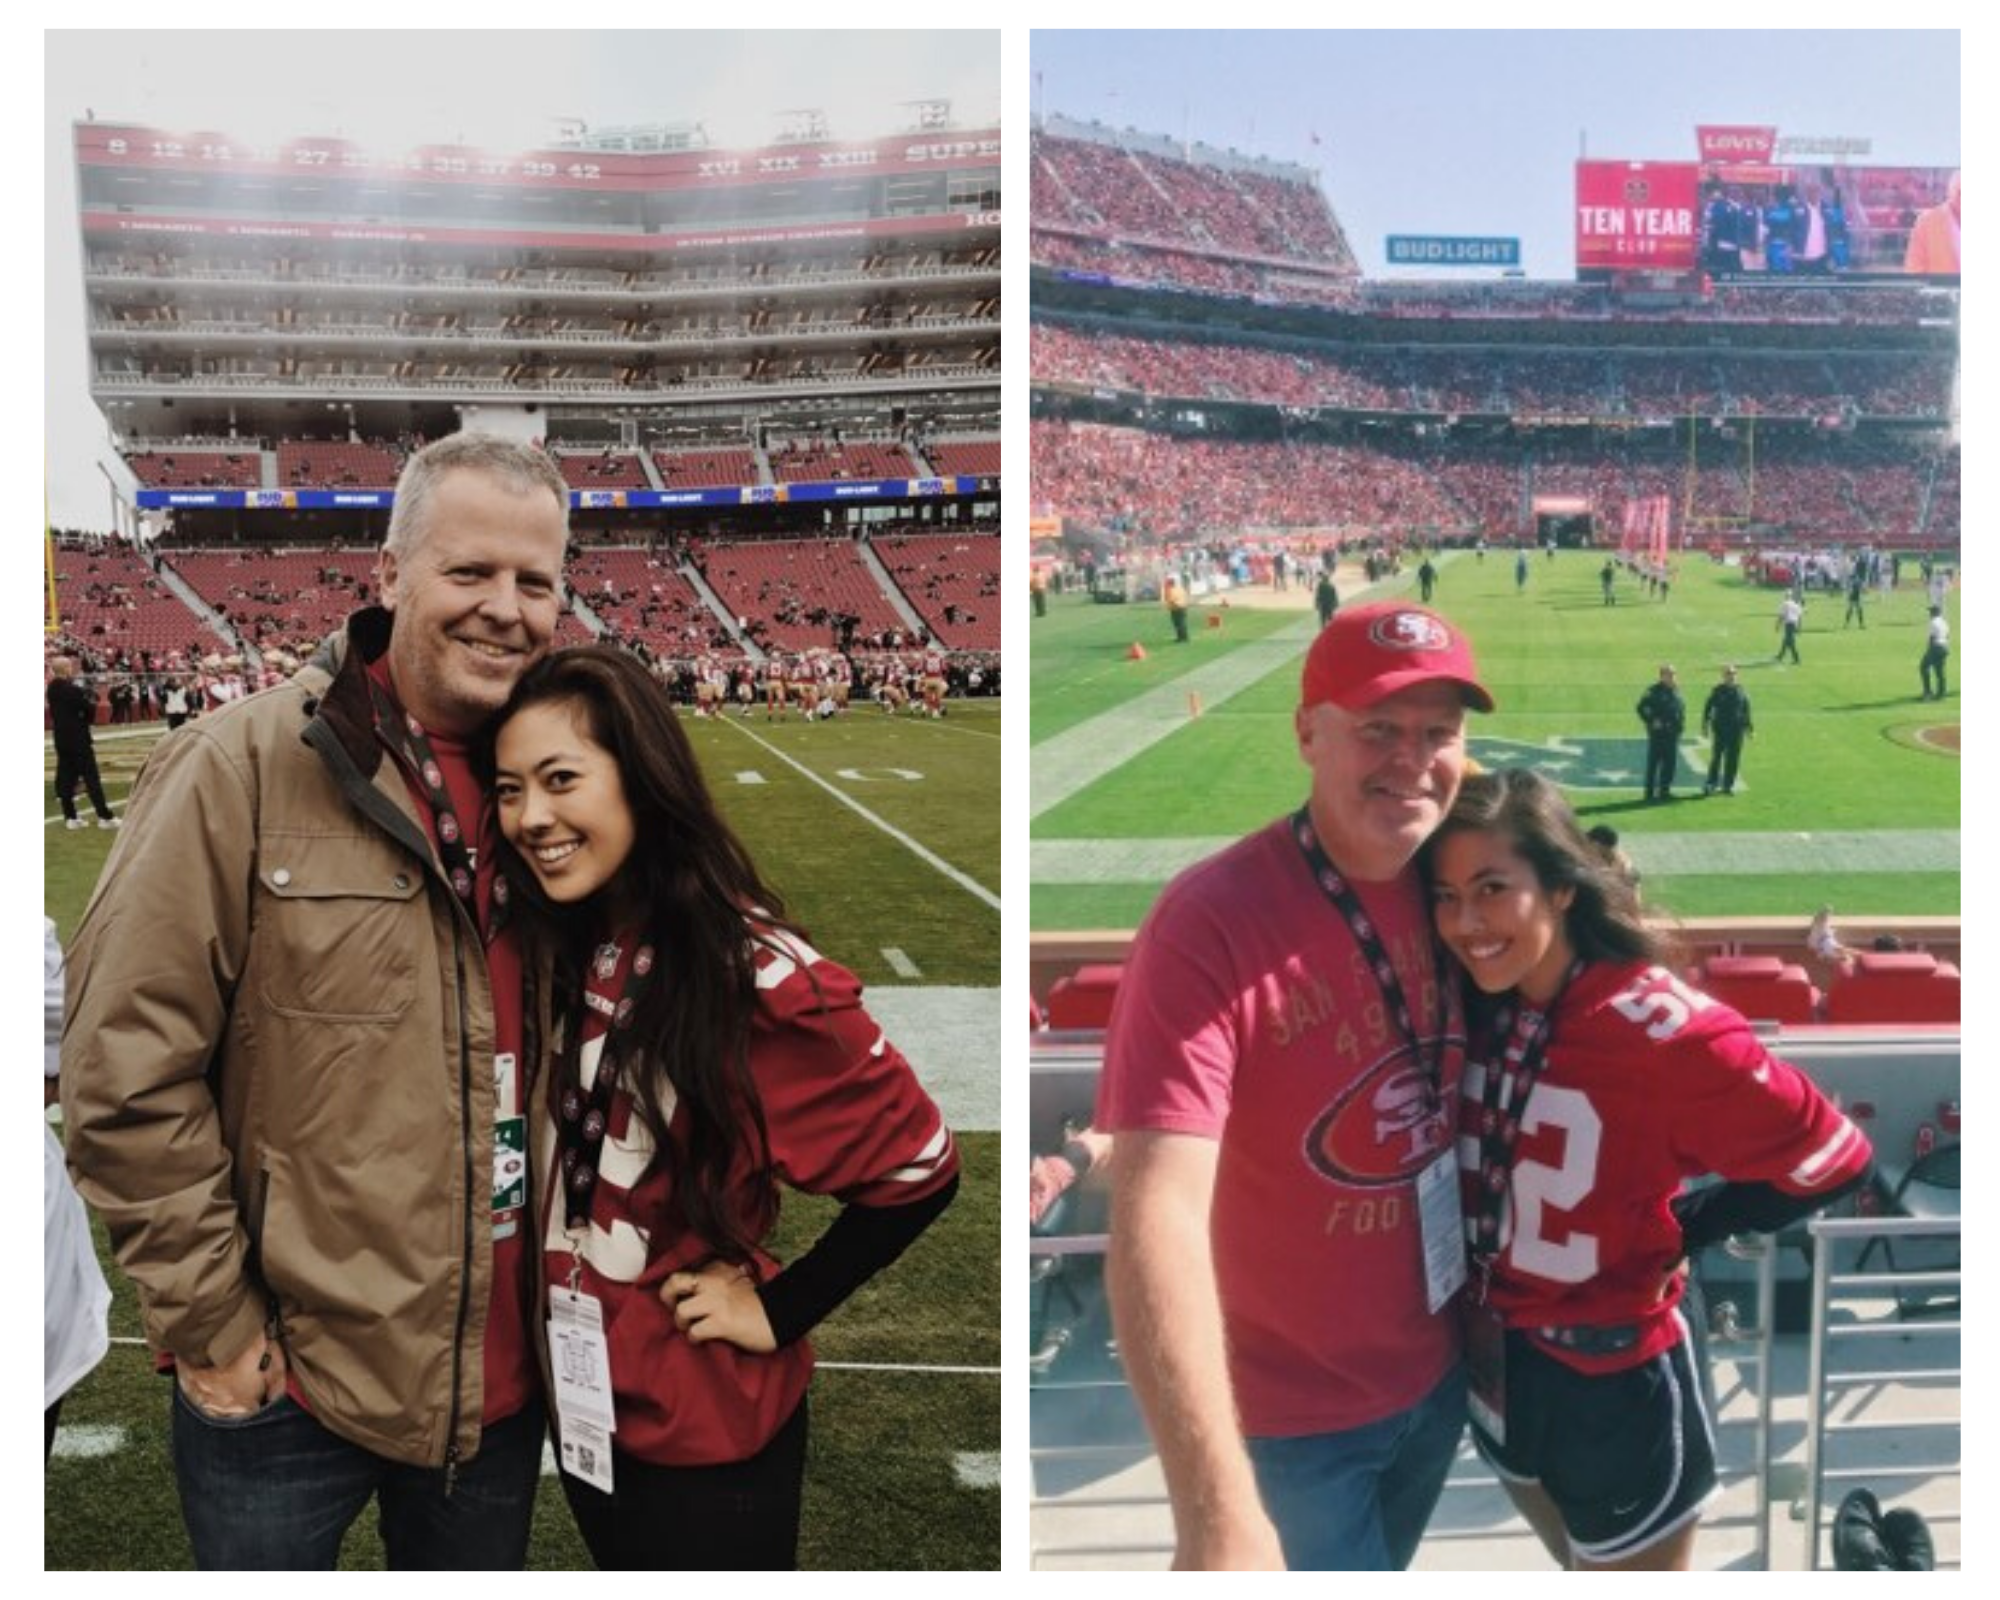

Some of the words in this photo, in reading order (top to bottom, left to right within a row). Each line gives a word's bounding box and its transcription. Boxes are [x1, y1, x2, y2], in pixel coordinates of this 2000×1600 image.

[108, 138, 128, 155] 8
[293, 150, 330, 166] 27
[566, 162, 601, 179] 42
[1579, 206, 1625, 235] TEN
[1632, 207, 1692, 236] YEAR
